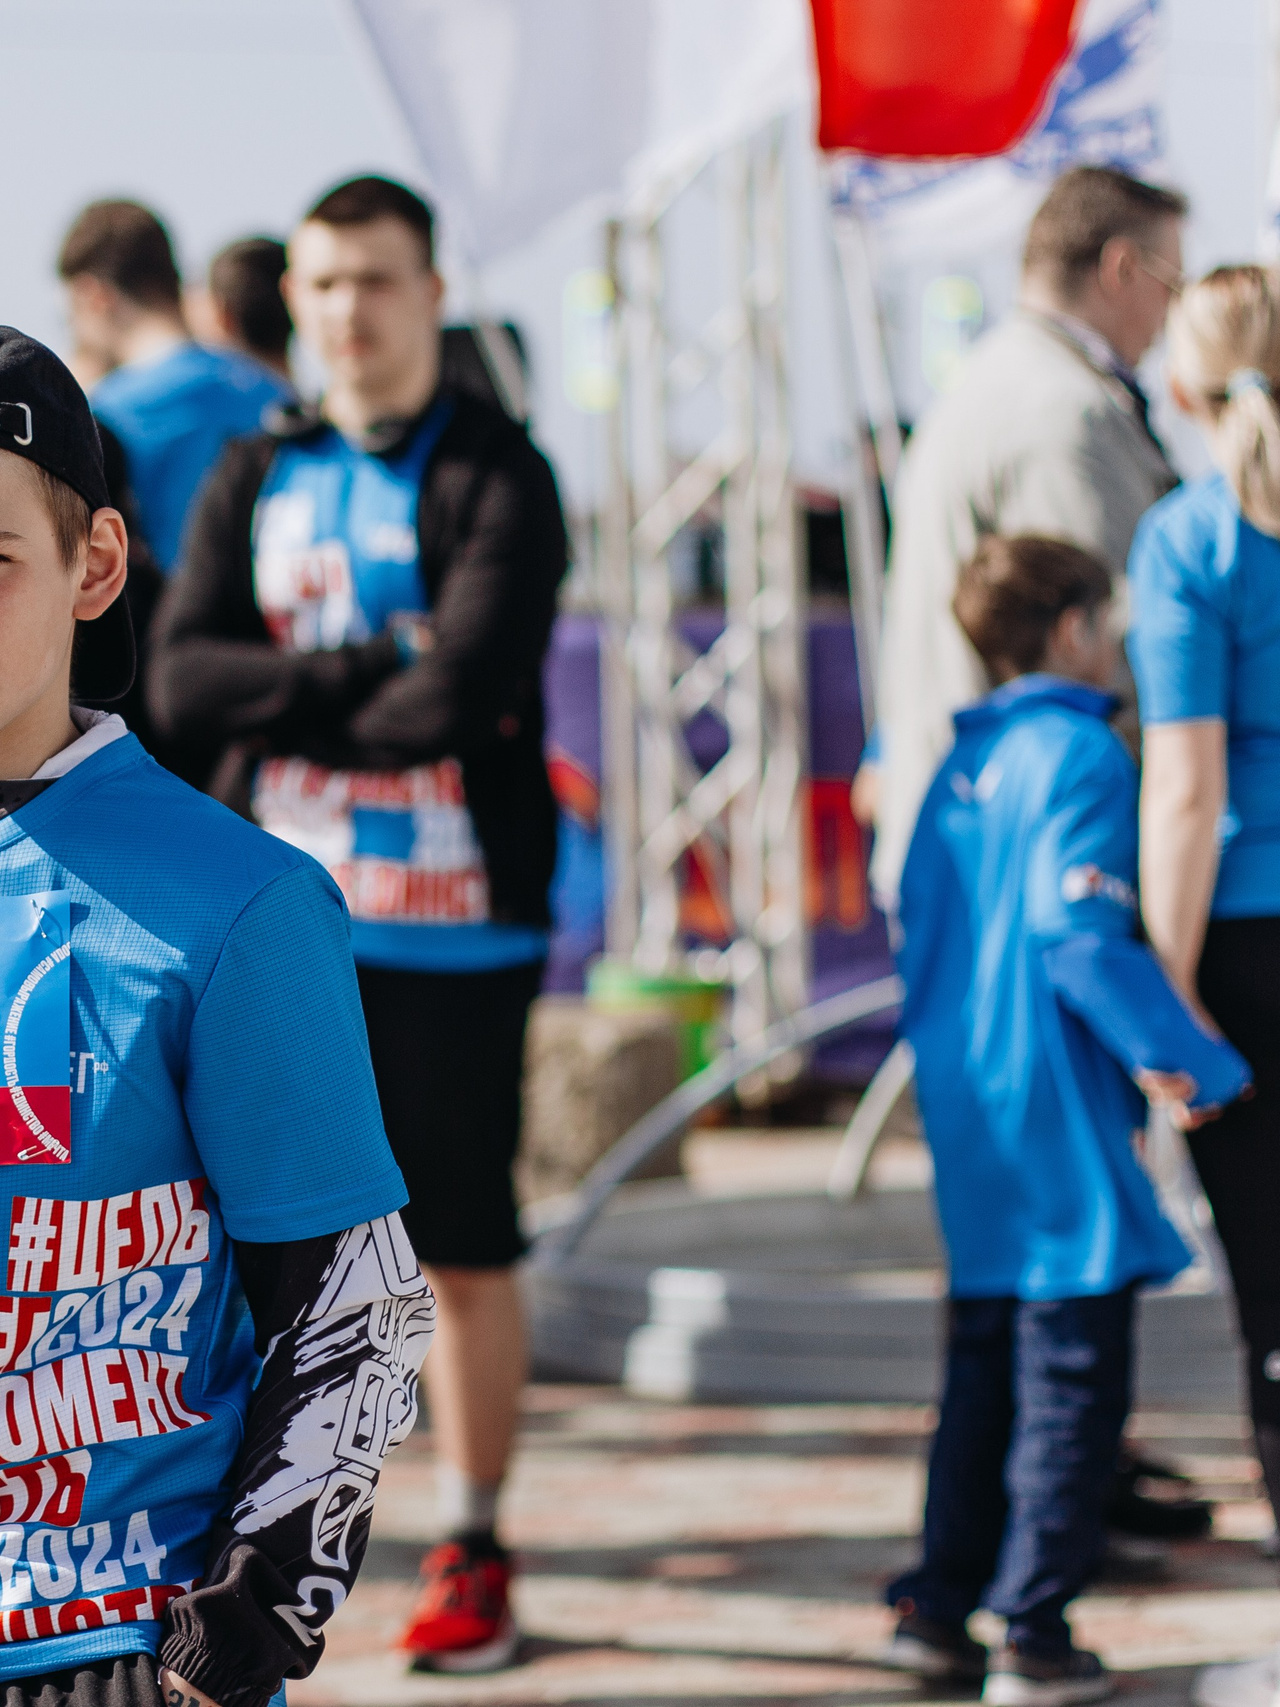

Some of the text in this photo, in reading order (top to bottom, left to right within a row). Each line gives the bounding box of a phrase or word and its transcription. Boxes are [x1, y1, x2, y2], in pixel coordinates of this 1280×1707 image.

[4, 956, 56, 1035] #САМОВЫРАЖЕНИЕ
[2, 1034, 20, 1088] #ГОРДОСТЬ
[8, 1085, 45, 1136] #ЕДИНСТВО
[8, 1176, 210, 1292] #ЦЕЛЬ
